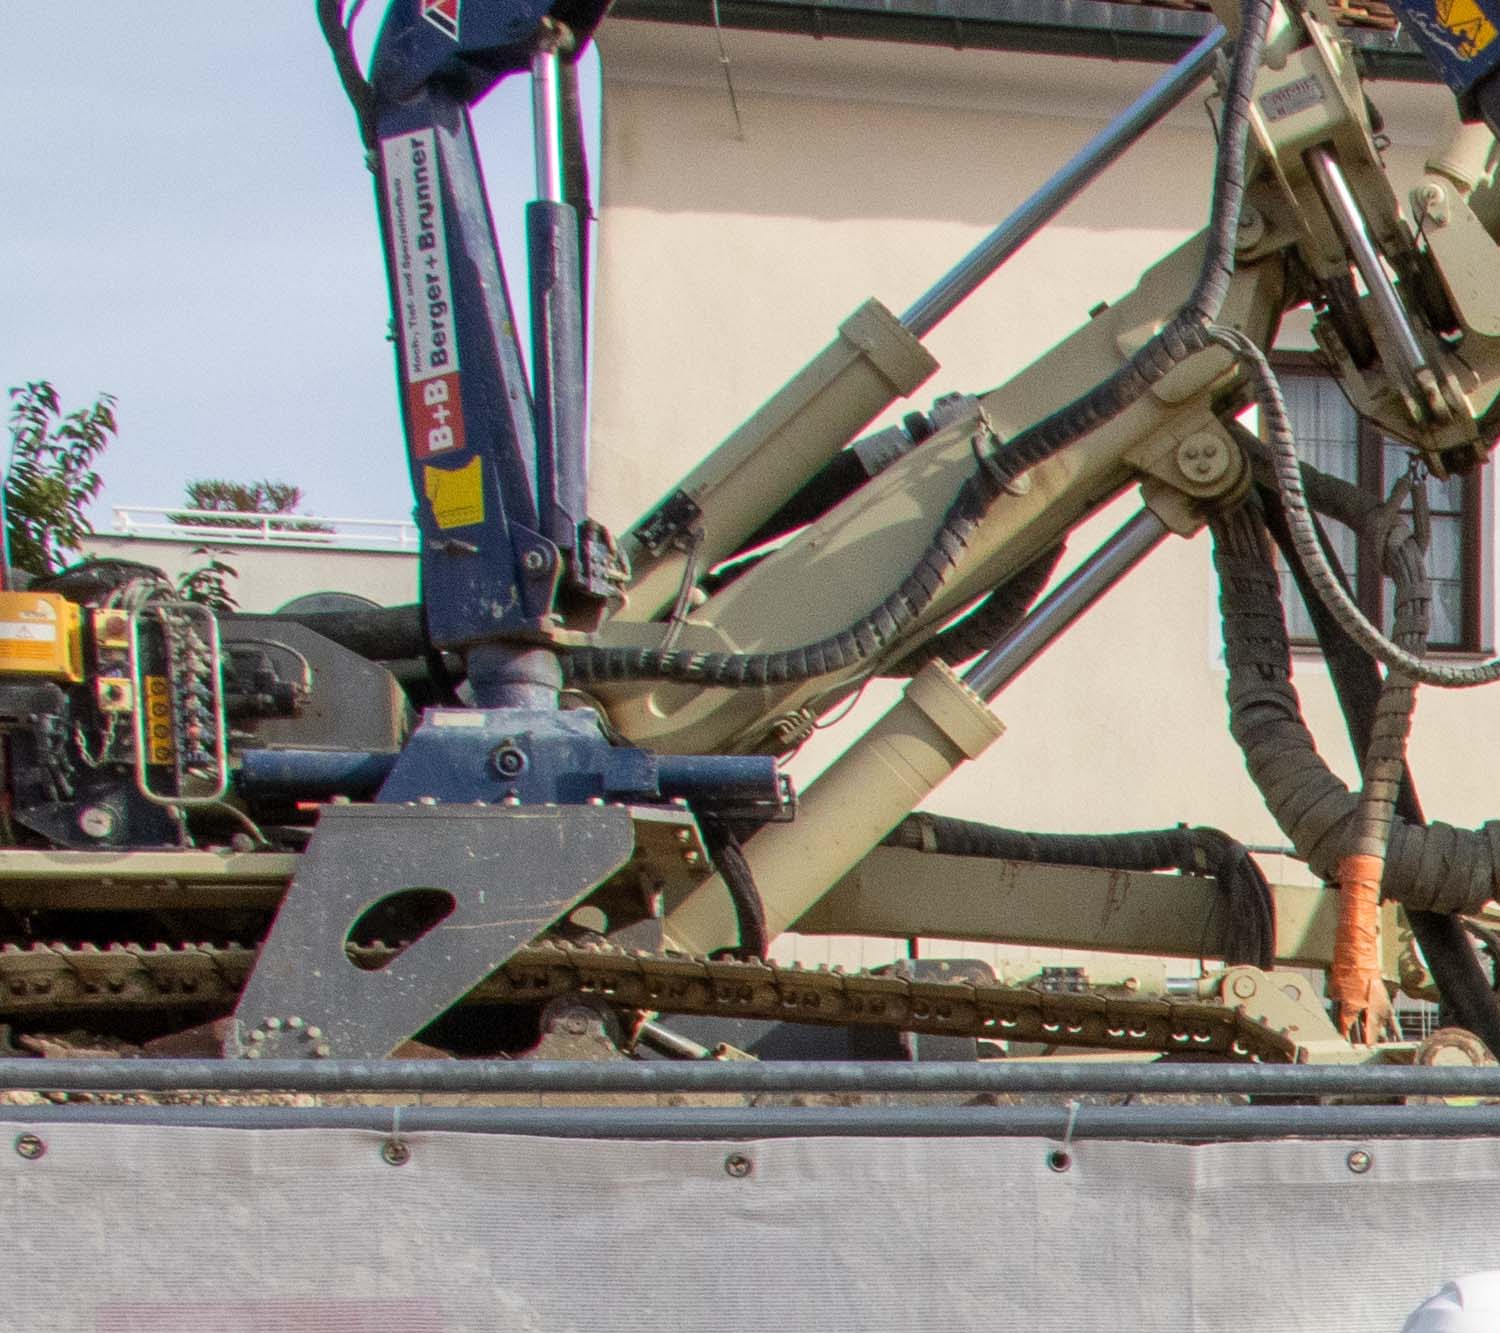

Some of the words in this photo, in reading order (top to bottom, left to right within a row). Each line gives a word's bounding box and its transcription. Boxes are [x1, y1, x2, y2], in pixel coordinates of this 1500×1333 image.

[410, 138, 437, 252] Brunner
[426, 273, 449, 367] Berger
[423, 378, 454, 452] B+B
